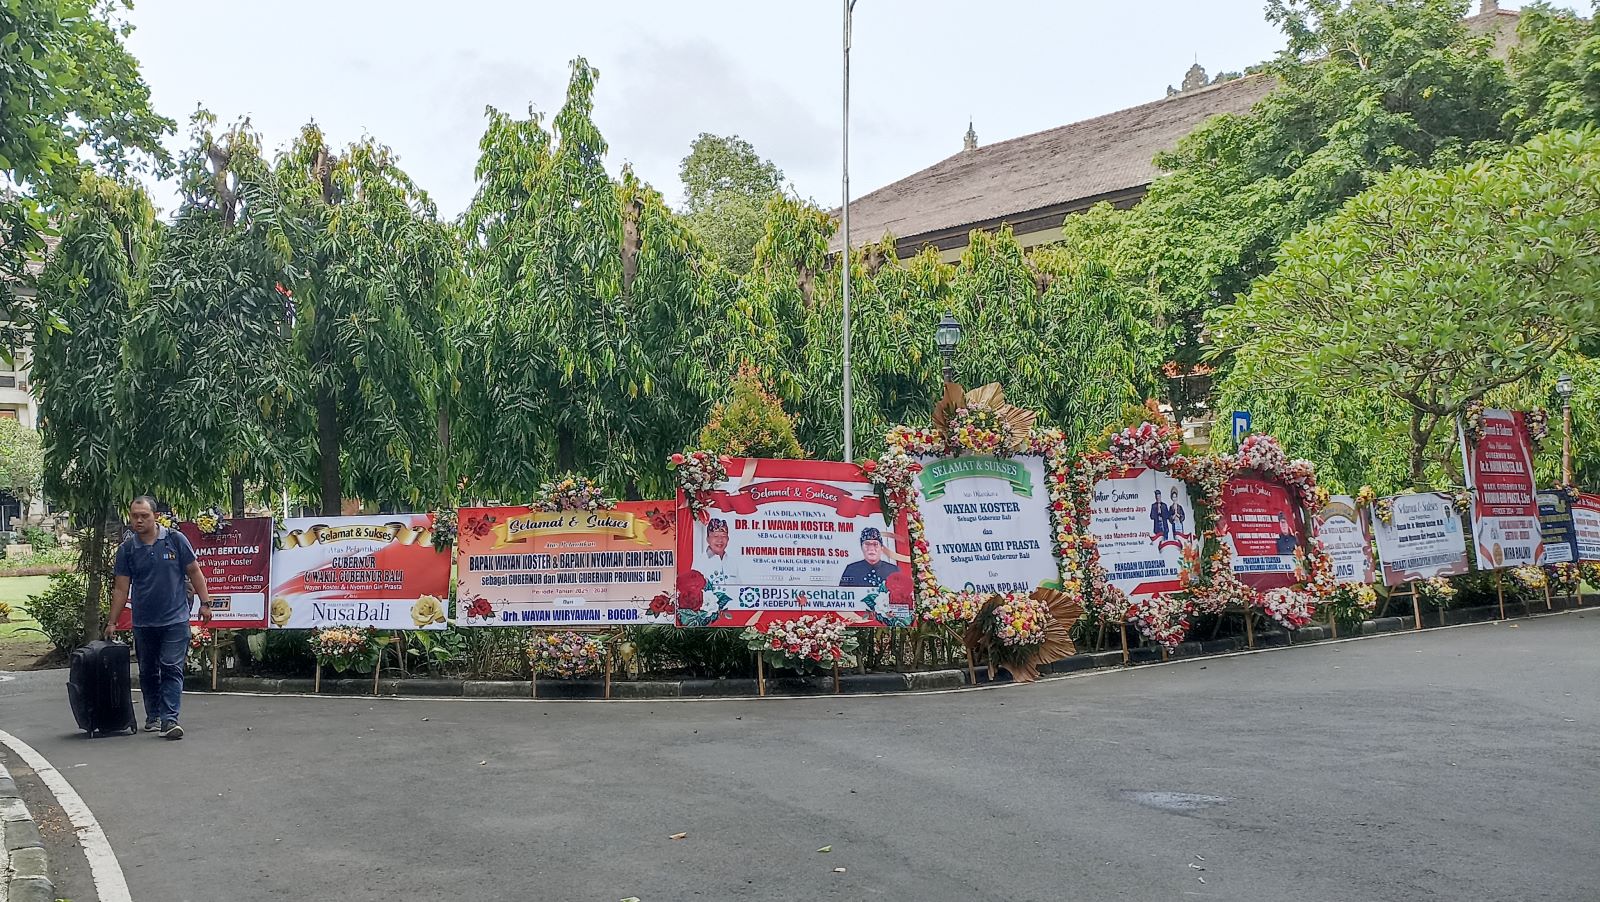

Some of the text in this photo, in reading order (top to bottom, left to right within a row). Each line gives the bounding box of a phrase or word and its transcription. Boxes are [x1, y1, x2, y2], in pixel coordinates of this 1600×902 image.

[932, 461, 1016, 477] SELAMAT & SUKSES
[750, 486, 838, 501] Selamat & Sukses
[944, 502, 1020, 514] WAYAN KOSTER
[510, 515, 628, 533] Selamat & Sukses
[735, 519, 750, 529] DR.
[752, 520, 760, 529] Ir.
[768, 520, 798, 531] WAYAN
[838, 522, 854, 532] MM
[320, 528, 392, 542] Selamat & Sukses
[195, 546, 259, 556] AMAT BERTUGAS
[746, 547, 777, 556] NYOMAN
[780, 548, 795, 556] GIRI
[936, 540, 1040, 554] I NYOMAN GIRI PRASTA
[208, 559, 229, 568] Wayan
[332, 557, 375, 568] GUBERNUR
[470, 556, 494, 571] BAPAK
[495, 555, 520, 570] WAYAN
[522, 554, 550, 569] KOSTER
[553, 557, 558, 568] &
[560, 554, 585, 568] BAPAK
[591, 552, 623, 568] NYOMAN
[626, 552, 641, 567] GIRI
[644, 551, 673, 566] PRASTA
[312, 571, 336, 582] WAKIL
[339, 570, 383, 582] GUBERNUR
[385, 570, 403, 581] BALI
[1336, 564, 1354, 576] JMSI
[482, 571, 660, 586] sebagai GUBERNUR dan WAKIL GUBERNUR PROVINSI BALI
[976, 582, 1029, 593] BANK BPD BALI
[762, 589, 855, 600] BPJS Kesehatan
[312, 602, 390, 620] NusaBali
[502, 610, 520, 621] Drh.
[522, 610, 550, 621] WAYAN
[553, 610, 600, 621] WIRYAWAN
[608, 609, 638, 620] BOGOR
